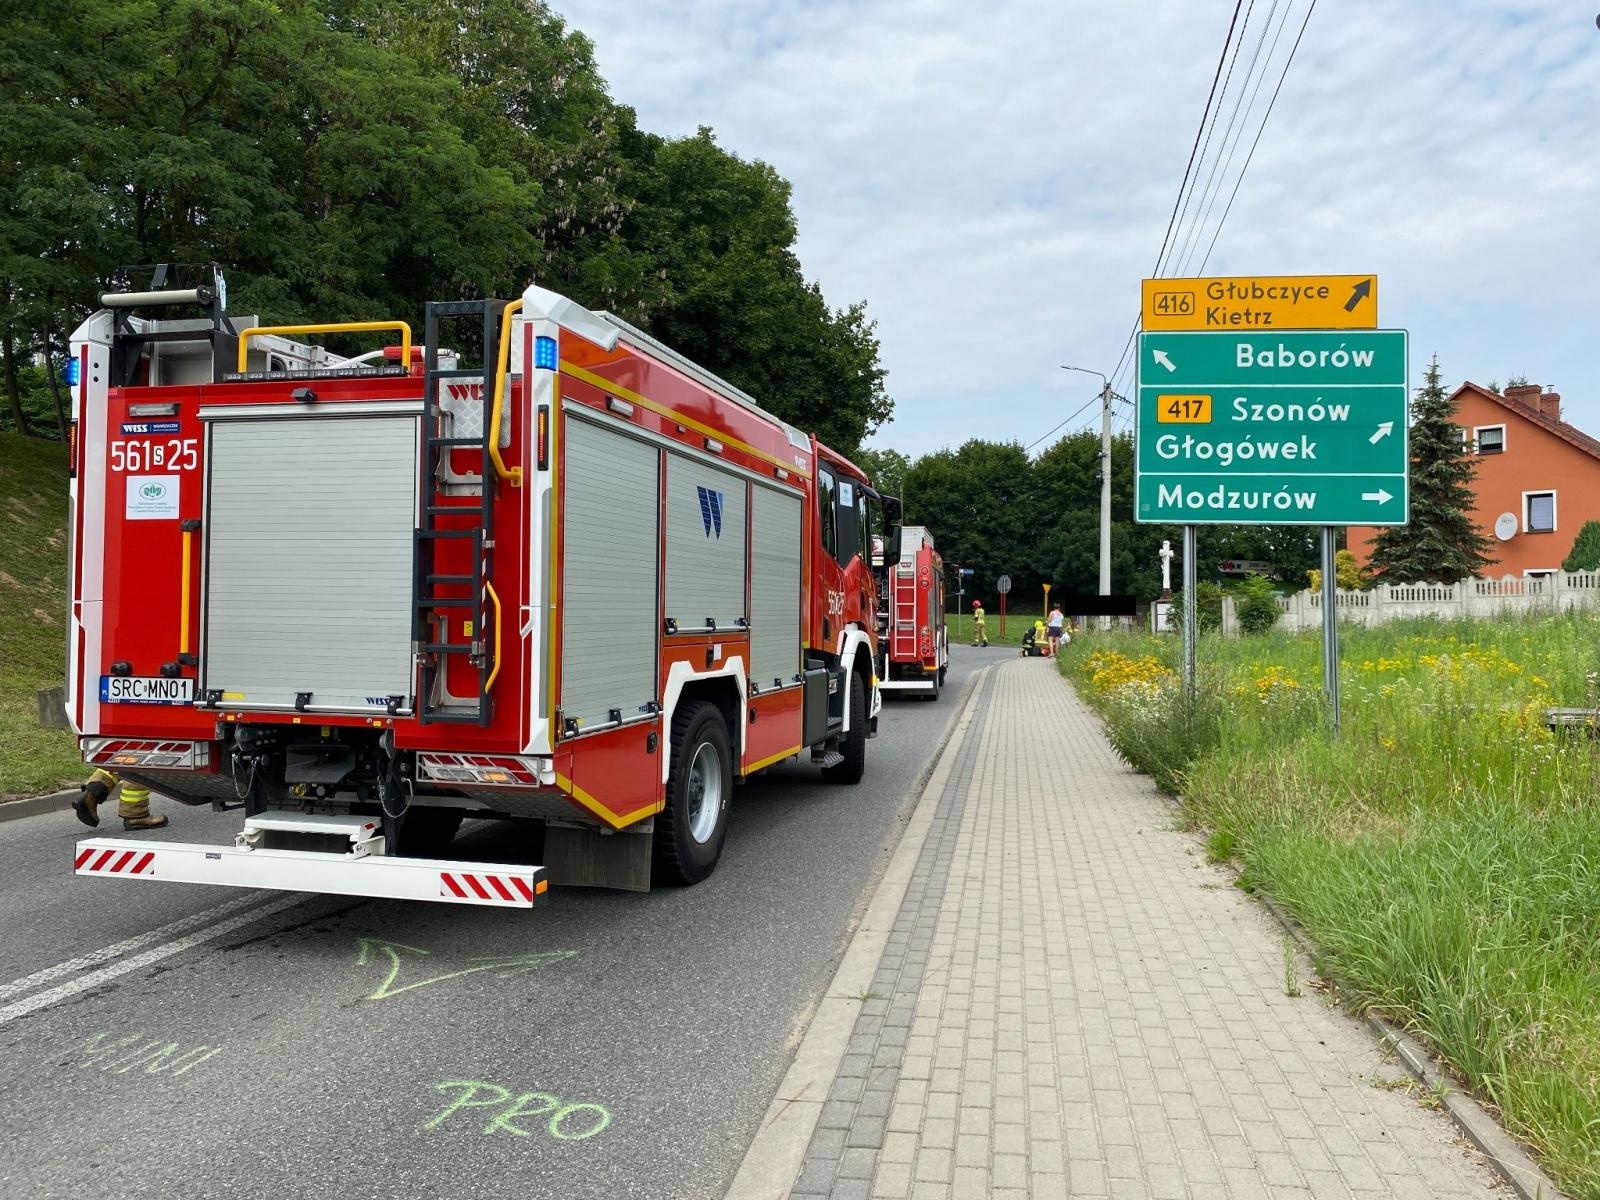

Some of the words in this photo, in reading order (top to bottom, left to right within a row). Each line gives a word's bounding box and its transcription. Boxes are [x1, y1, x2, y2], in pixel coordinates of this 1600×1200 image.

[1157, 295, 1191, 313] 416
[1206, 281, 1329, 305] Głubczyce
[1206, 307, 1272, 325] Kietrz
[1236, 342, 1375, 368] Baborów
[1167, 401, 1204, 418] 417
[1231, 397, 1350, 422] Szonów
[111, 440, 150, 472] 561
[167, 439, 198, 471] 25
[1155, 434, 1317, 467] Głogówek
[1158, 484, 1317, 510] Modzurów
[112, 679, 142, 697] SRC
[148, 679, 187, 699] MN01
[423, 1079, 611, 1140] PRO
